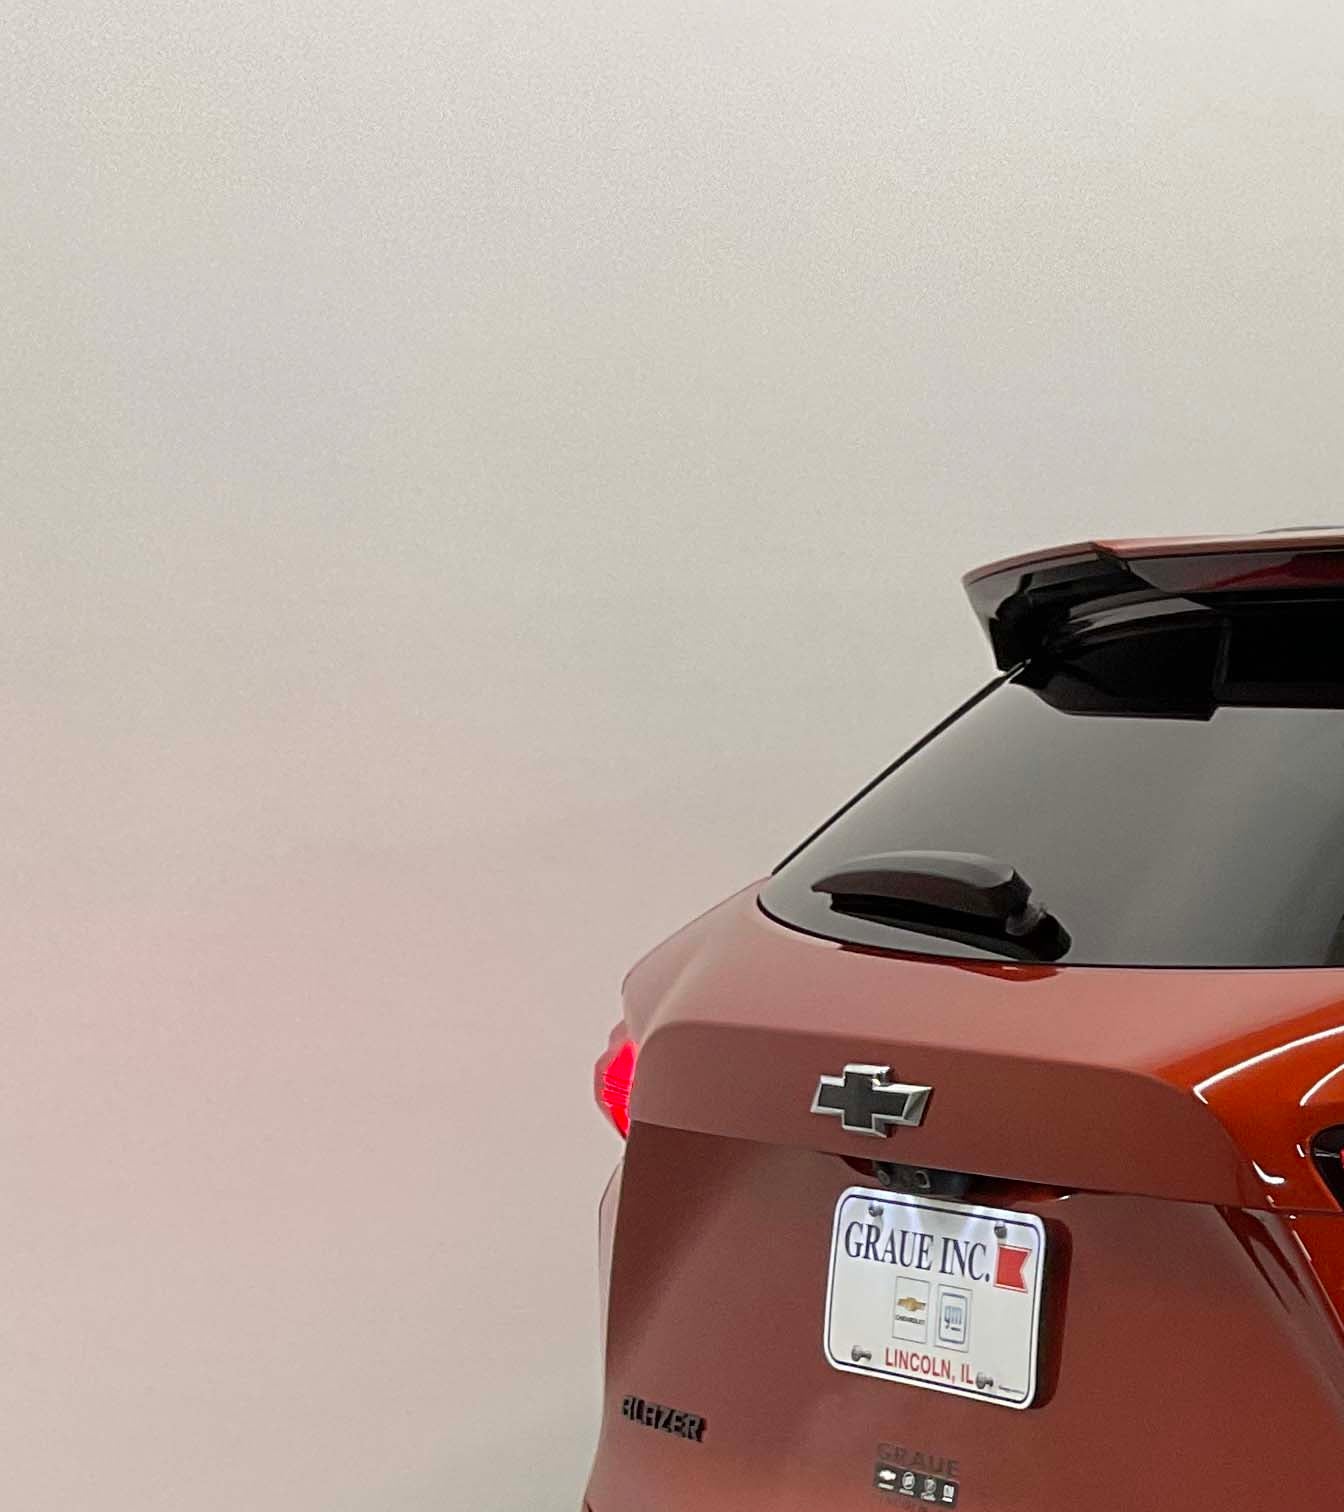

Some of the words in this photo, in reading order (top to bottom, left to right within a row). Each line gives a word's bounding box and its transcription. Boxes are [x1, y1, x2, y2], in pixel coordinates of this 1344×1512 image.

[844, 1220, 934, 1272] GRAUE
[938, 1236, 991, 1283] INC.
[884, 1347, 957, 1385] LINCOLN,
[959, 1363, 975, 1385] IL
[622, 1394, 708, 1444] BLAZER
